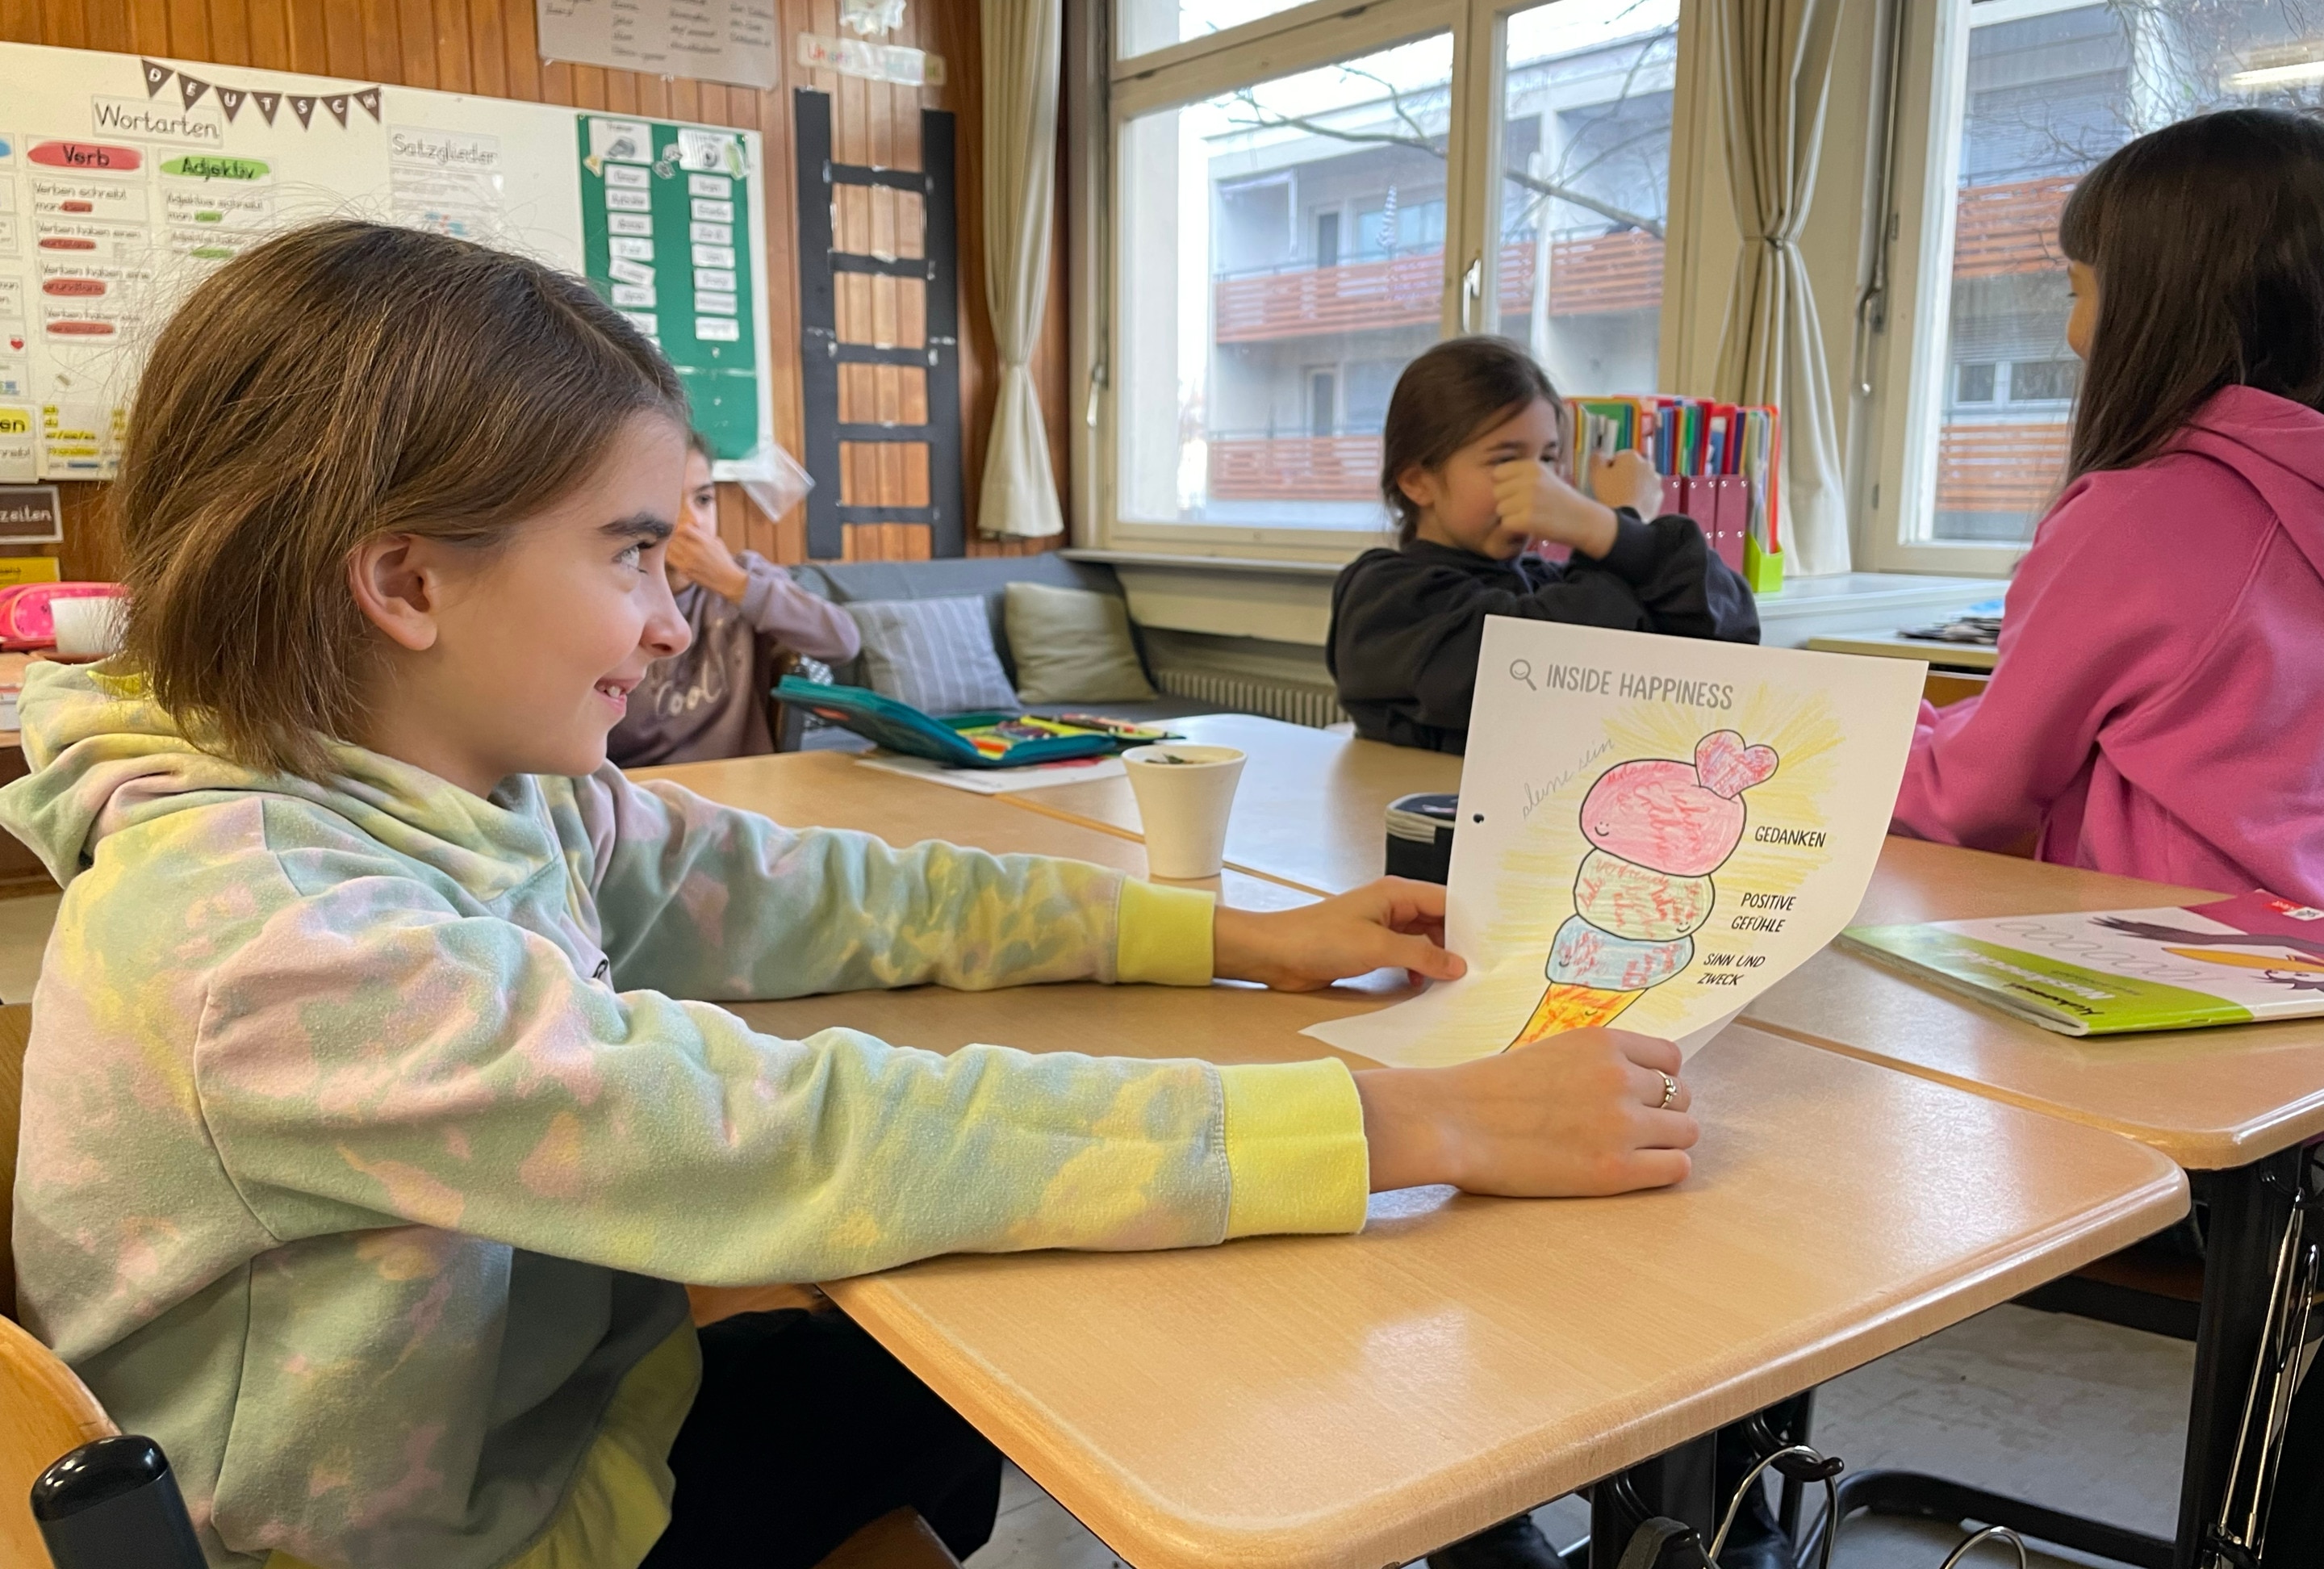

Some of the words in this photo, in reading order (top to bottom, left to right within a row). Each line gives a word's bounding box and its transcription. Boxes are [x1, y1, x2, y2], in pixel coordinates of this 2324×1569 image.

[94, 102, 219, 139] Wortarten
[63, 144, 110, 166] Verb
[392, 133, 498, 165] Satzglieder
[182, 157, 255, 182] Adjektiv
[1546, 663, 1612, 695] INSIDE
[1619, 672, 1733, 710] HAPPINESS
[1754, 826, 1826, 847] GEDANKEN
[1741, 893, 1796, 911] POSITIVE
[1731, 915, 1786, 932] GEFÜHLE
[1703, 952, 1736, 967] SINN
[1736, 955, 1766, 968] UND
[1697, 973, 1744, 985] ZWECK
